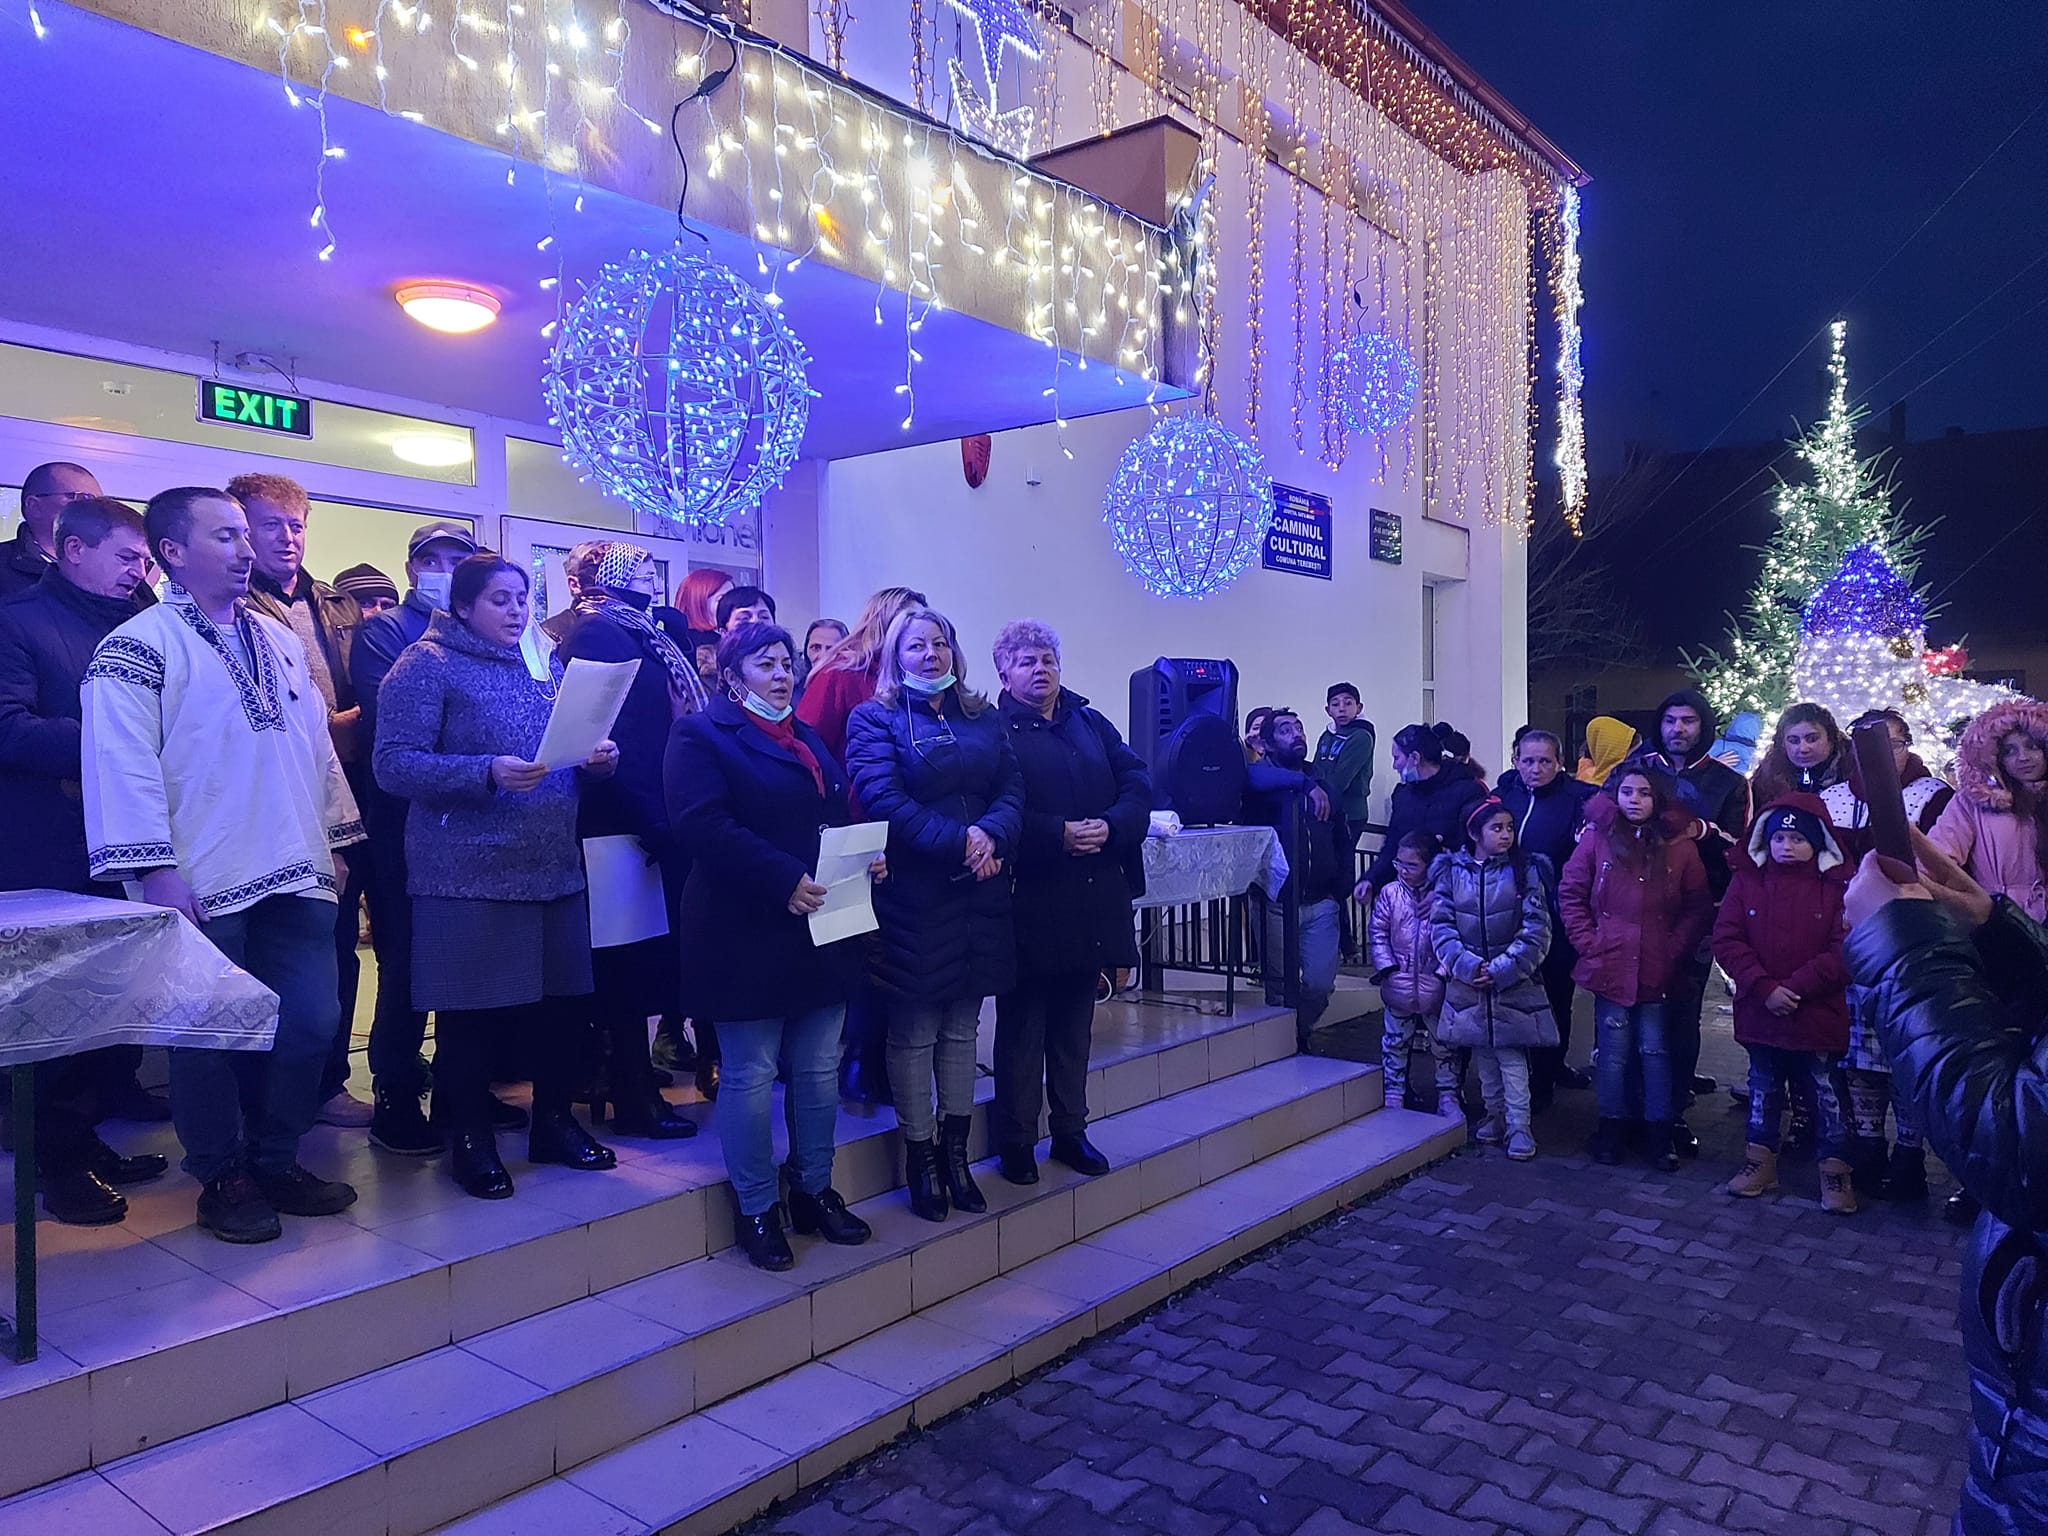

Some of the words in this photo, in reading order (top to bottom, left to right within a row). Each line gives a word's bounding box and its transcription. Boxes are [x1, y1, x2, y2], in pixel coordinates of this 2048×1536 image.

[215, 387, 297, 428] EXIT
[1274, 516, 1323, 541] CAMINUL
[1270, 535, 1326, 561] CULTURAL
